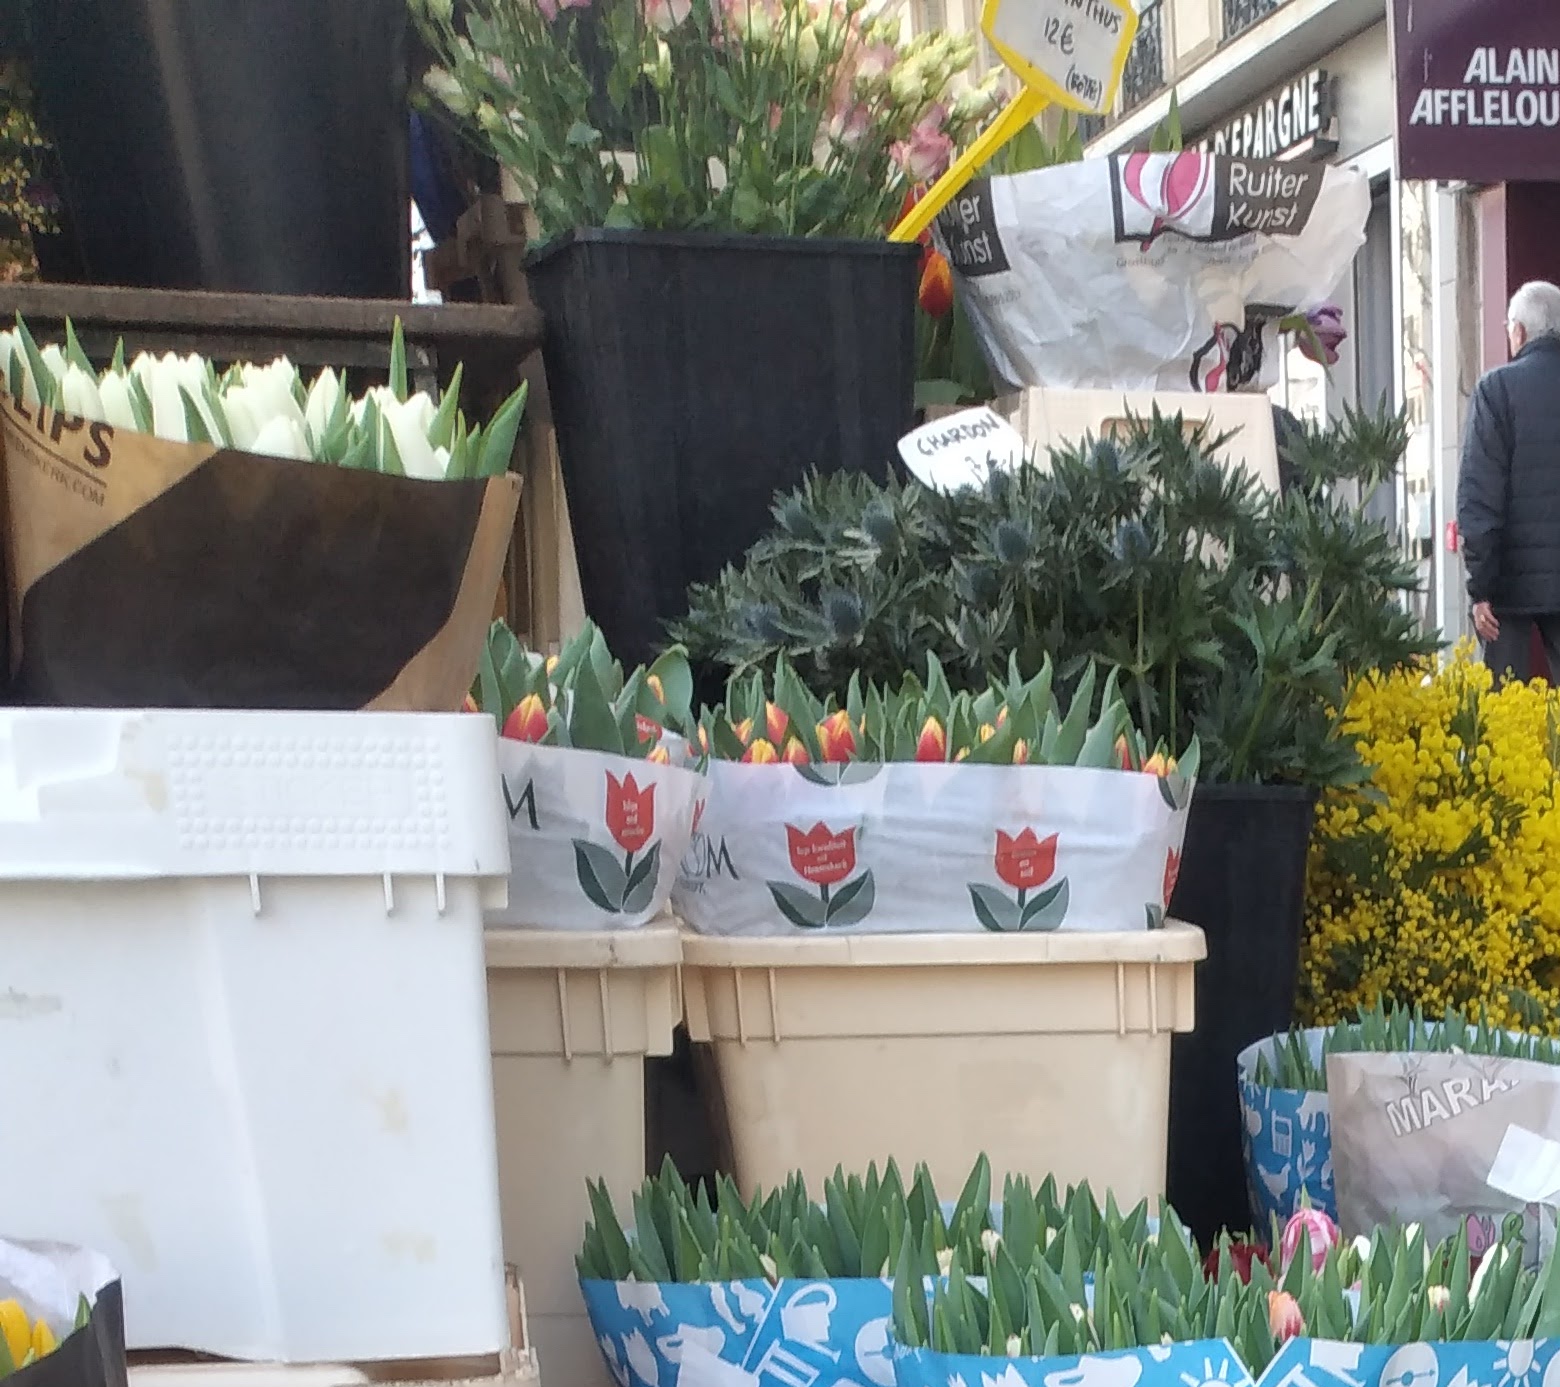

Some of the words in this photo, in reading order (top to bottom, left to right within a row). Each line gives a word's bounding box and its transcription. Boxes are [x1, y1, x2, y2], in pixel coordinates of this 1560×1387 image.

[1463, 46, 1560, 85] ALAIN
[1408, 87, 1560, 127] AFFLELOU
[1228, 161, 1309, 198] Ruiter
[1225, 200, 1298, 231] Kunst
